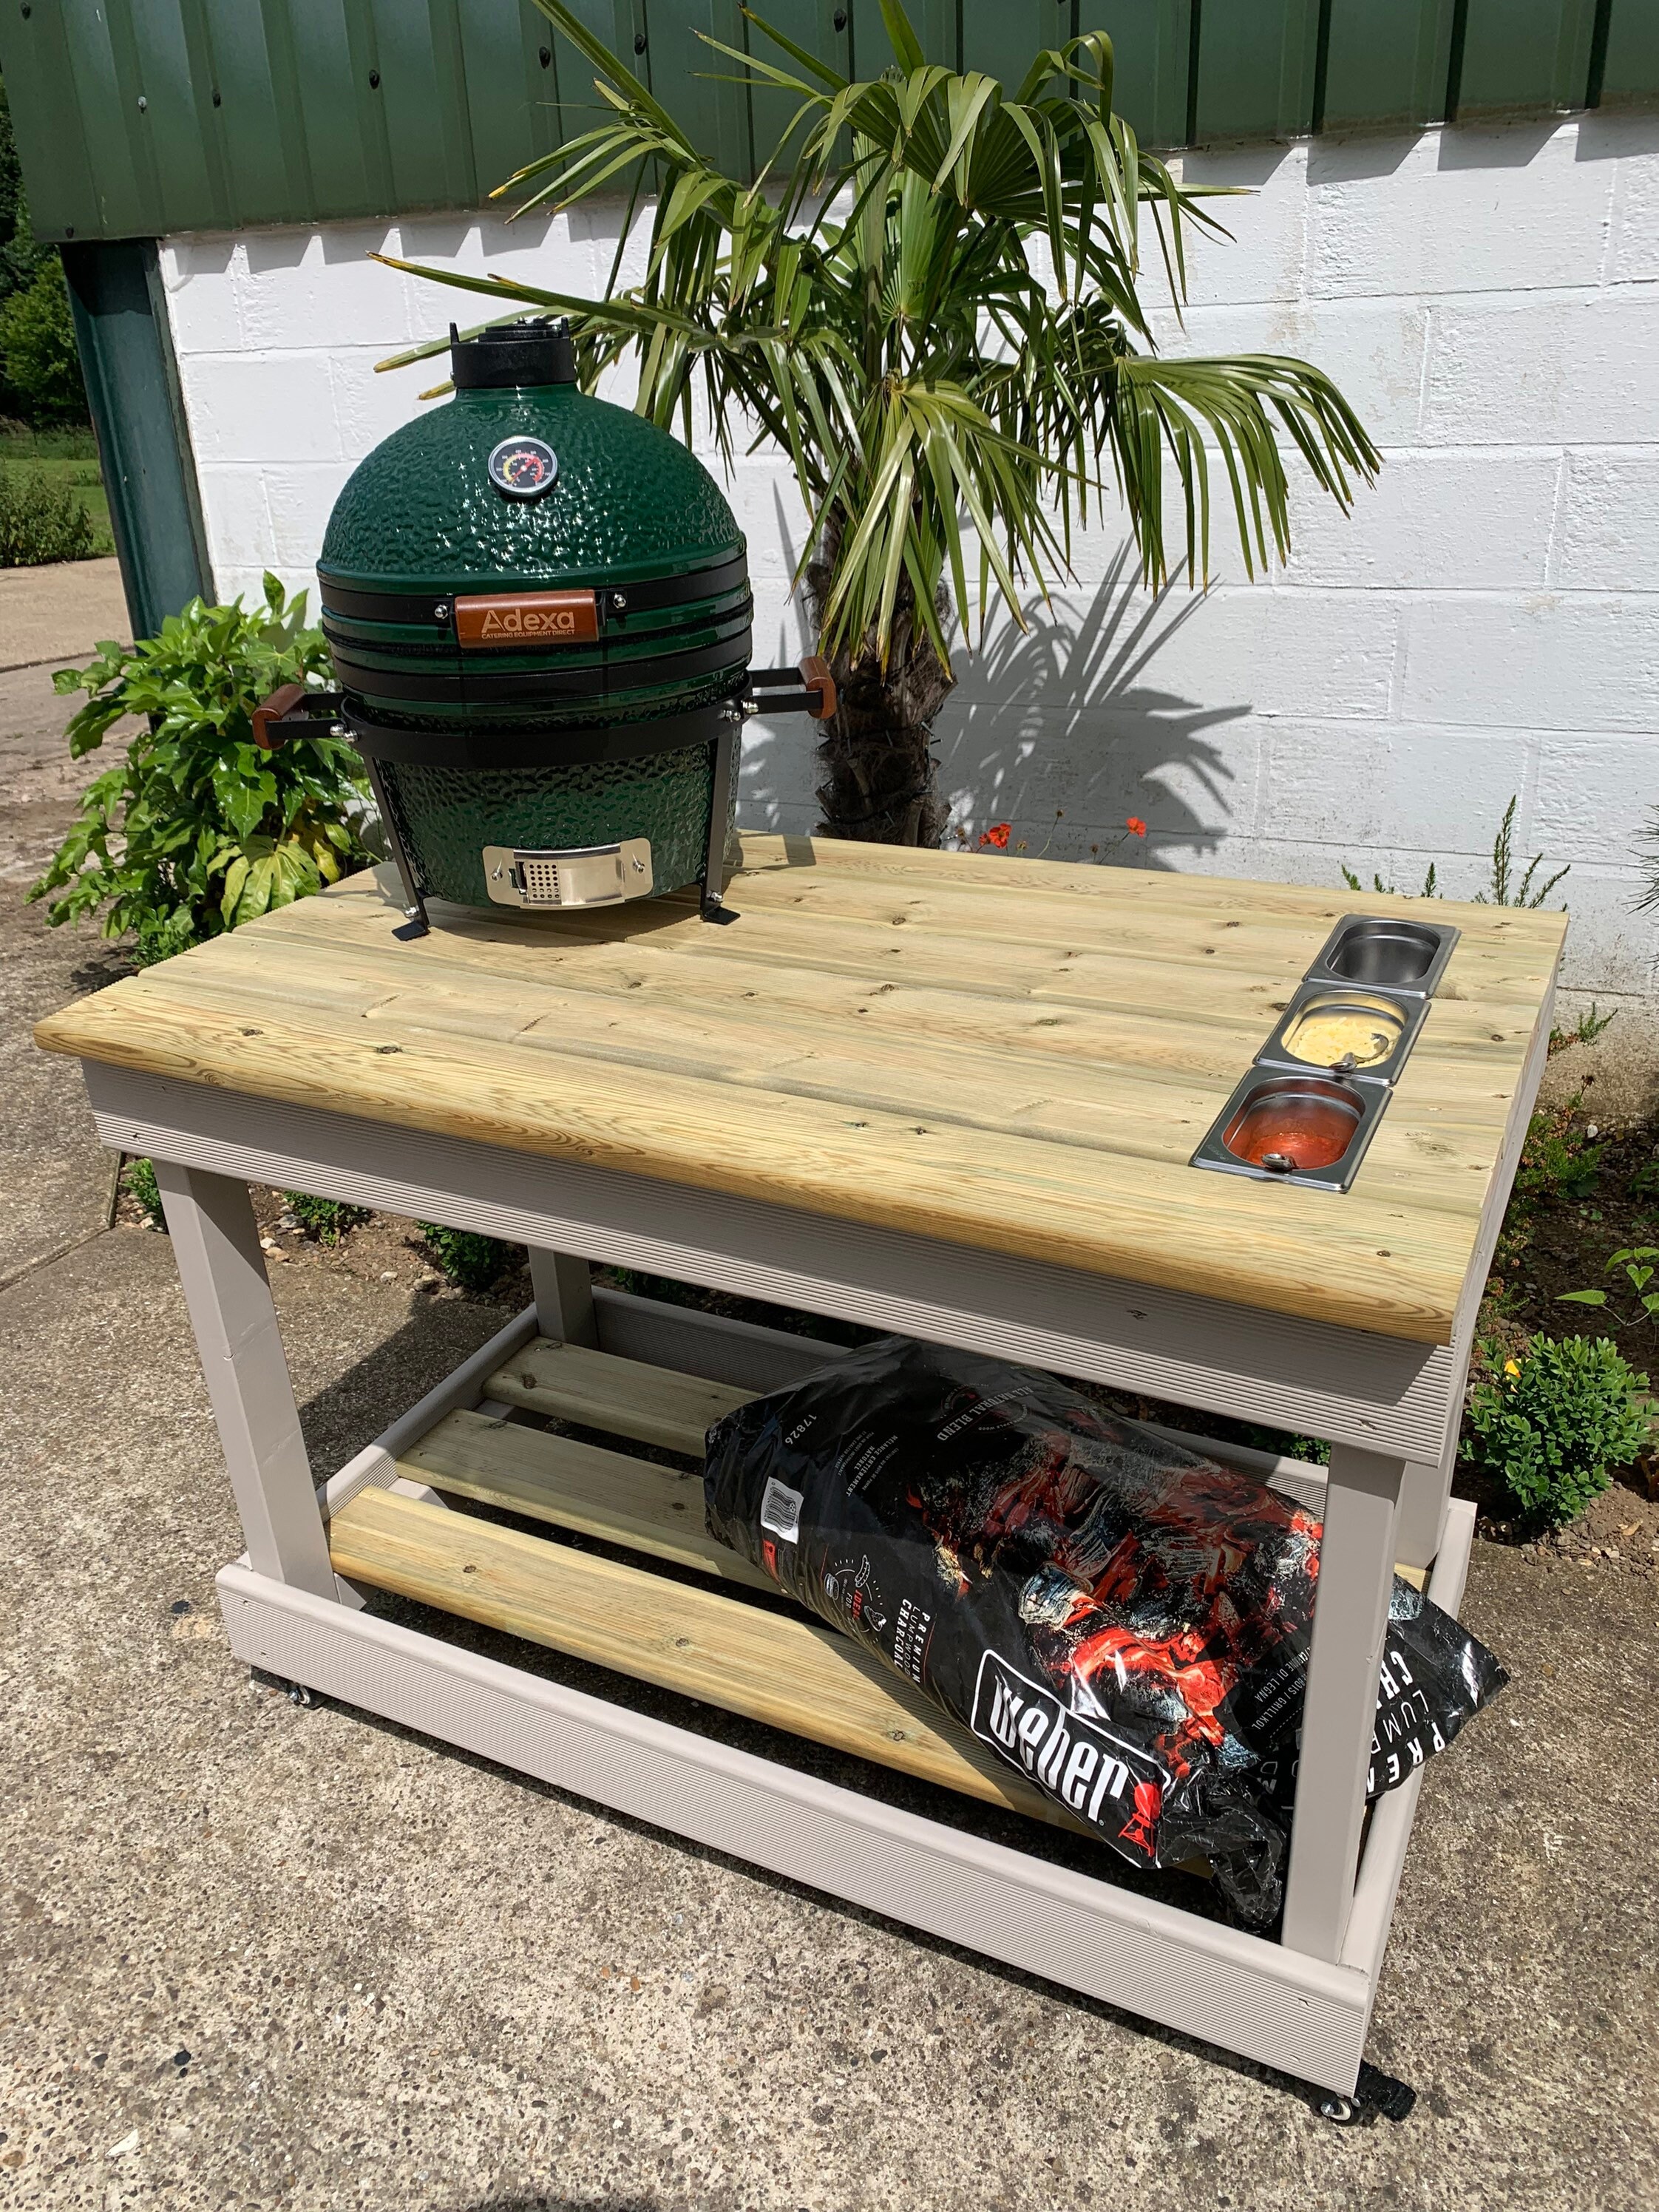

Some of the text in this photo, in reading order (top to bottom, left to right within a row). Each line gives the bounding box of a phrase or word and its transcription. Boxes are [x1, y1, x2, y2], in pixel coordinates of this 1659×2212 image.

[481, 608, 574, 634] Adexa
[968, 1390, 1017, 1415] NATURAL
[1011, 1385, 1034, 1397] ALL
[784, 1414, 818, 1445] 17826
[936, 1413, 974, 1442] BLEND
[853, 1445, 875, 1470] NATUREL
[873, 1435, 898, 1456] MÉLANGE
[895, 1599, 912, 1667] CHARCOAL
[905, 1607, 920, 1676] LUMPWOOD
[912, 1612, 931, 1683] PREMIUM
[1277, 1669, 1289, 1680] DI
[1288, 1677, 1307, 1694] BOIS
[1377, 1651, 1413, 1709] CH
[1255, 1678, 1280, 1702] LEGNA
[1252, 1697, 1286, 1729] GRILLKOL
[990, 1674, 1129, 1822] weber
